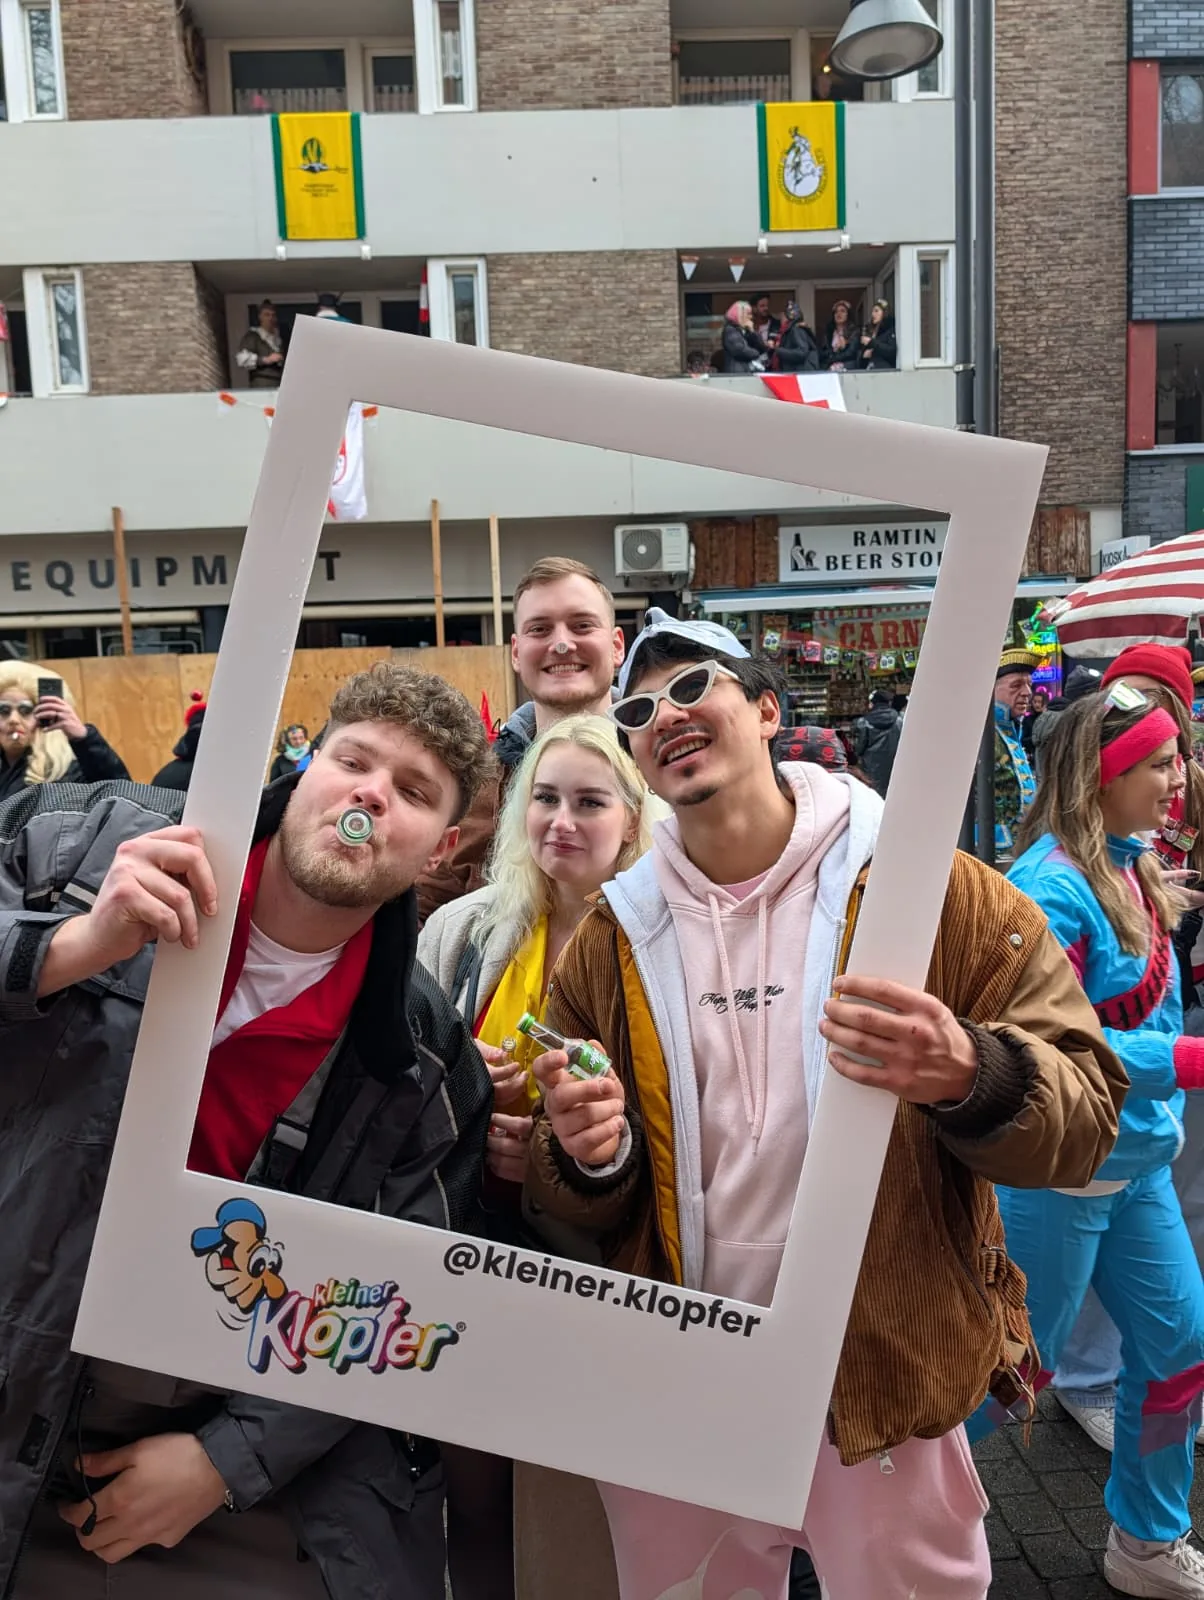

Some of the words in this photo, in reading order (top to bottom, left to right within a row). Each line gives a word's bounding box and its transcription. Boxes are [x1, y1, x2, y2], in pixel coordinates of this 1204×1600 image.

[853, 528, 936, 547] RAMTIN
[10, 551, 340, 597] EQUIPMT
[825, 553, 882, 571] BEER
[839, 619, 928, 650] CARN
[314, 1278, 399, 1309] kleiner
[443, 1242, 761, 1337] @kleiner.klopfer
